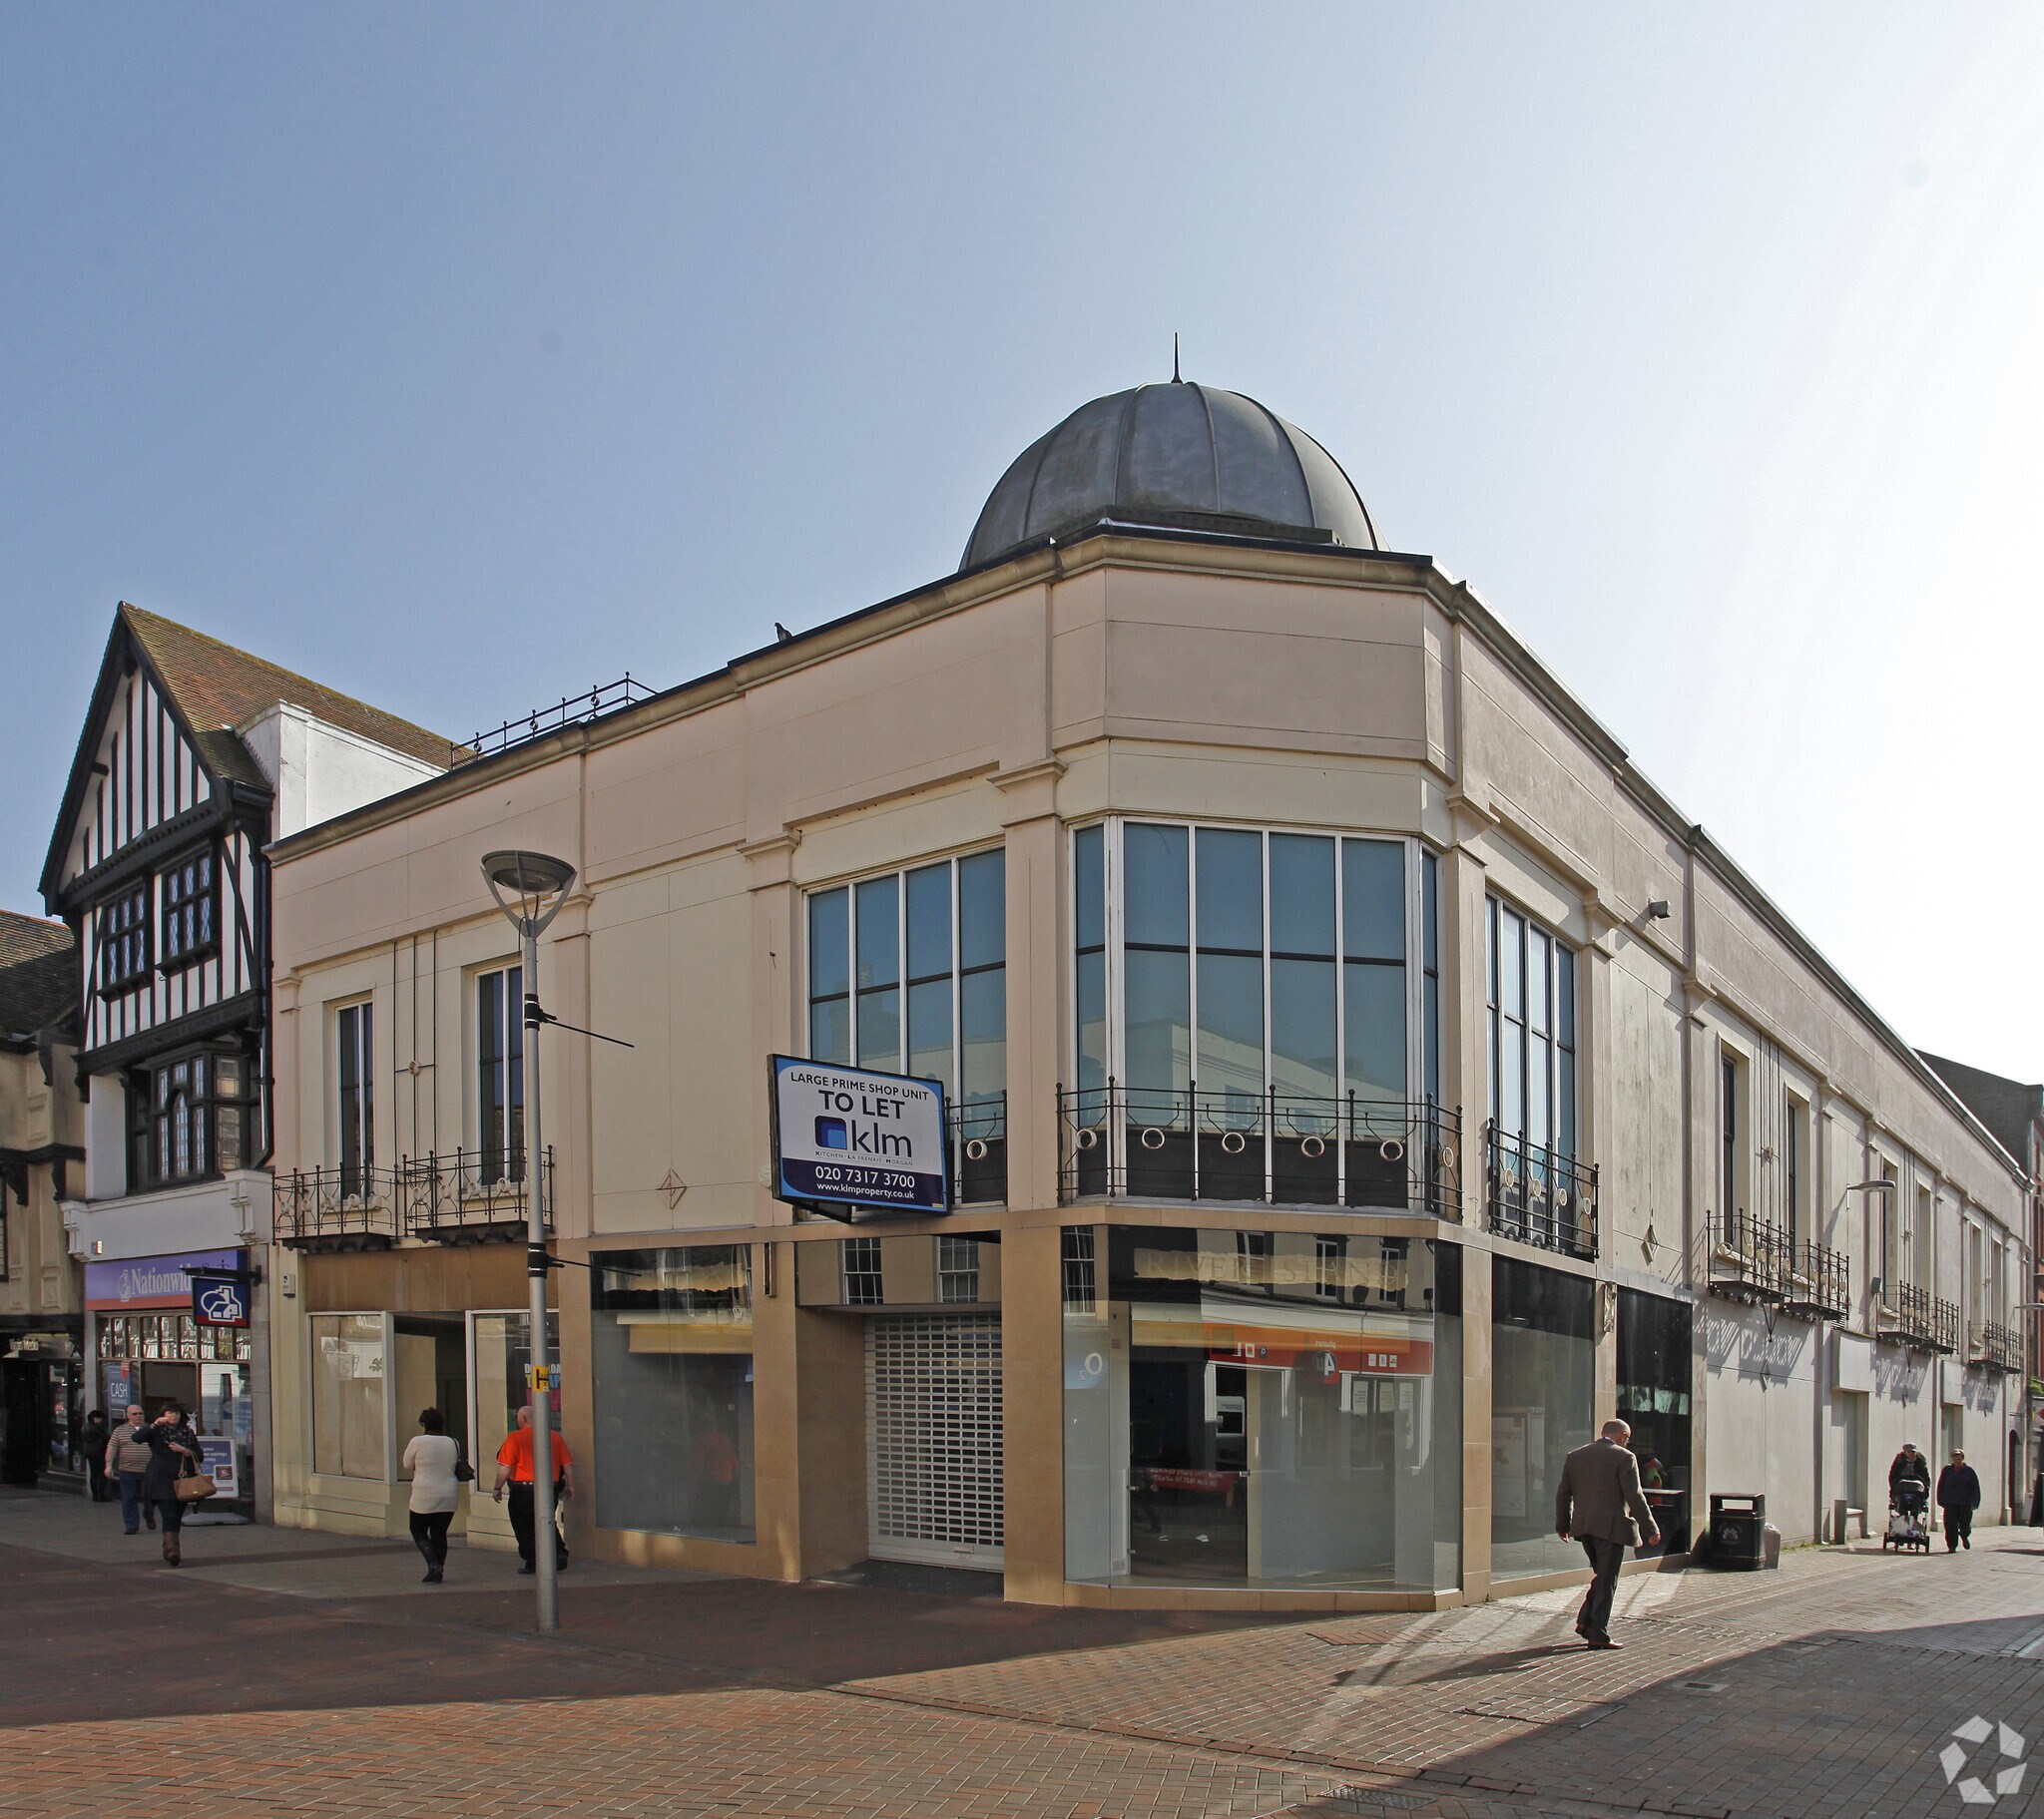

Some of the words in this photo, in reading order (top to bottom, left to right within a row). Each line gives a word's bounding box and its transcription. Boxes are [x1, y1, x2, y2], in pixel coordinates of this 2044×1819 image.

[790, 1072, 828, 1086] LARGE
[832, 1079, 865, 1092] PRIME
[869, 1085, 898, 1096] SHOP
[902, 1089, 929, 1100] UNIT
[818, 1090, 853, 1113] TO
[862, 1096, 905, 1119] LET
[851, 1120, 912, 1157] klm
[815, 1165, 841, 1180] 020
[845, 1168, 878, 1184] 7317
[883, 1172, 915, 1188] 3700
[816, 1182, 915, 1199] www.klmproperty.co.uk
[131, 1263, 193, 1295] Nationwid
[1148, 1254, 1261, 1279] RIVER
[111, 1382, 128, 1398] CASH
